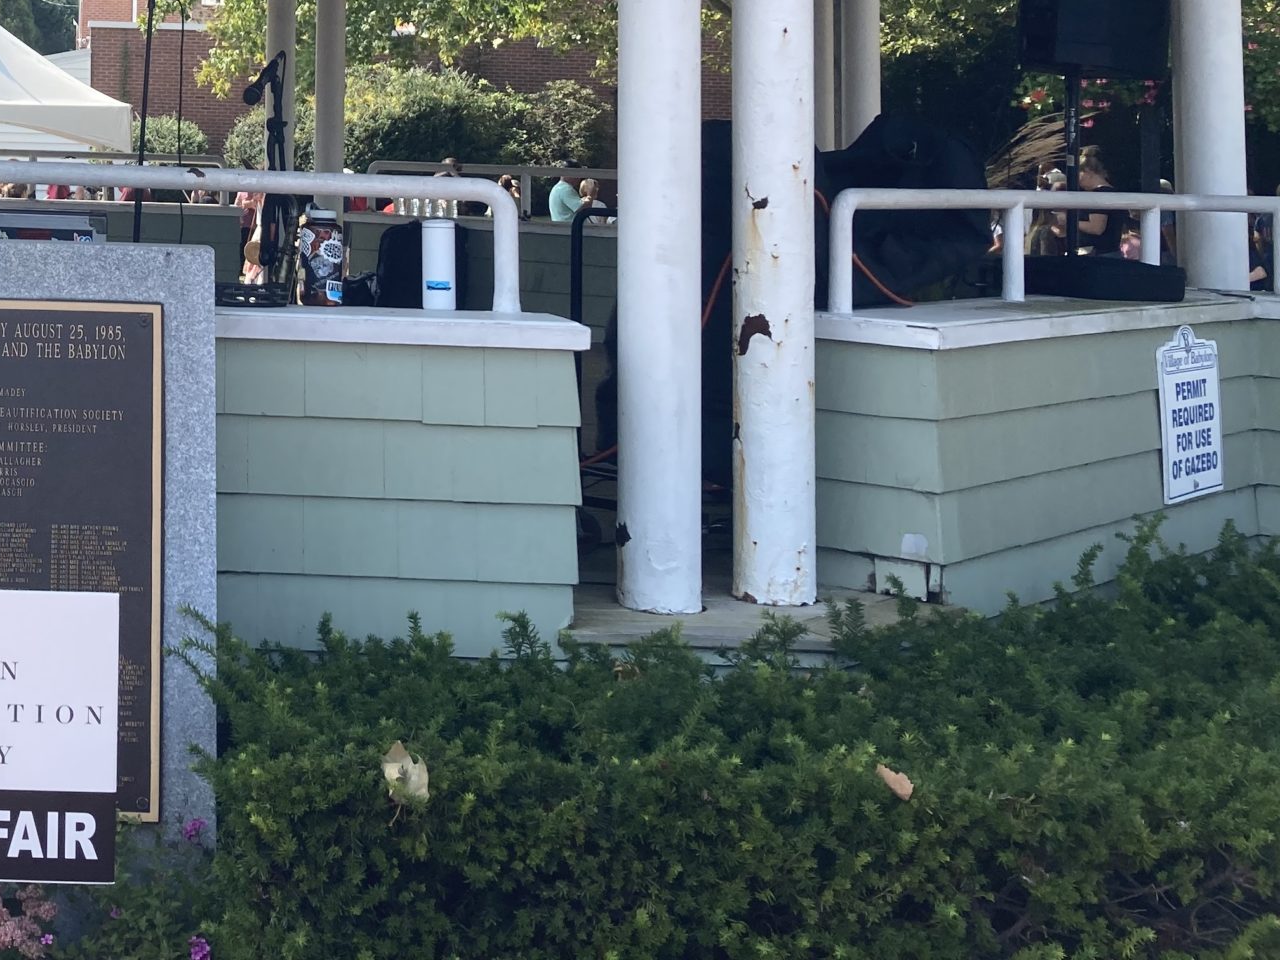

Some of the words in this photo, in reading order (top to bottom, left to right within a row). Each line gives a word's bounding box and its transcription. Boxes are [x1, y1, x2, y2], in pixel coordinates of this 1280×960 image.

[14, 323, 63, 339] AUGUST
[70, 324, 88, 341] 25,
[95, 325, 126, 342] 1985,
[1, 342, 28, 358] AND
[36, 342, 61, 359] THE
[68, 344, 126, 361] BABYLON
[1175, 379, 1207, 401] PERMIT
[82, 409, 125, 422] SOCIETY
[1172, 403, 1214, 428] REQUIRED
[52, 424, 98, 434] PRESIDENT
[1176, 432, 1193, 452] FOR
[1195, 428, 1212, 448] USE
[1172, 459, 1183, 480] OF
[1185, 451, 1218, 476] GAZEBO
